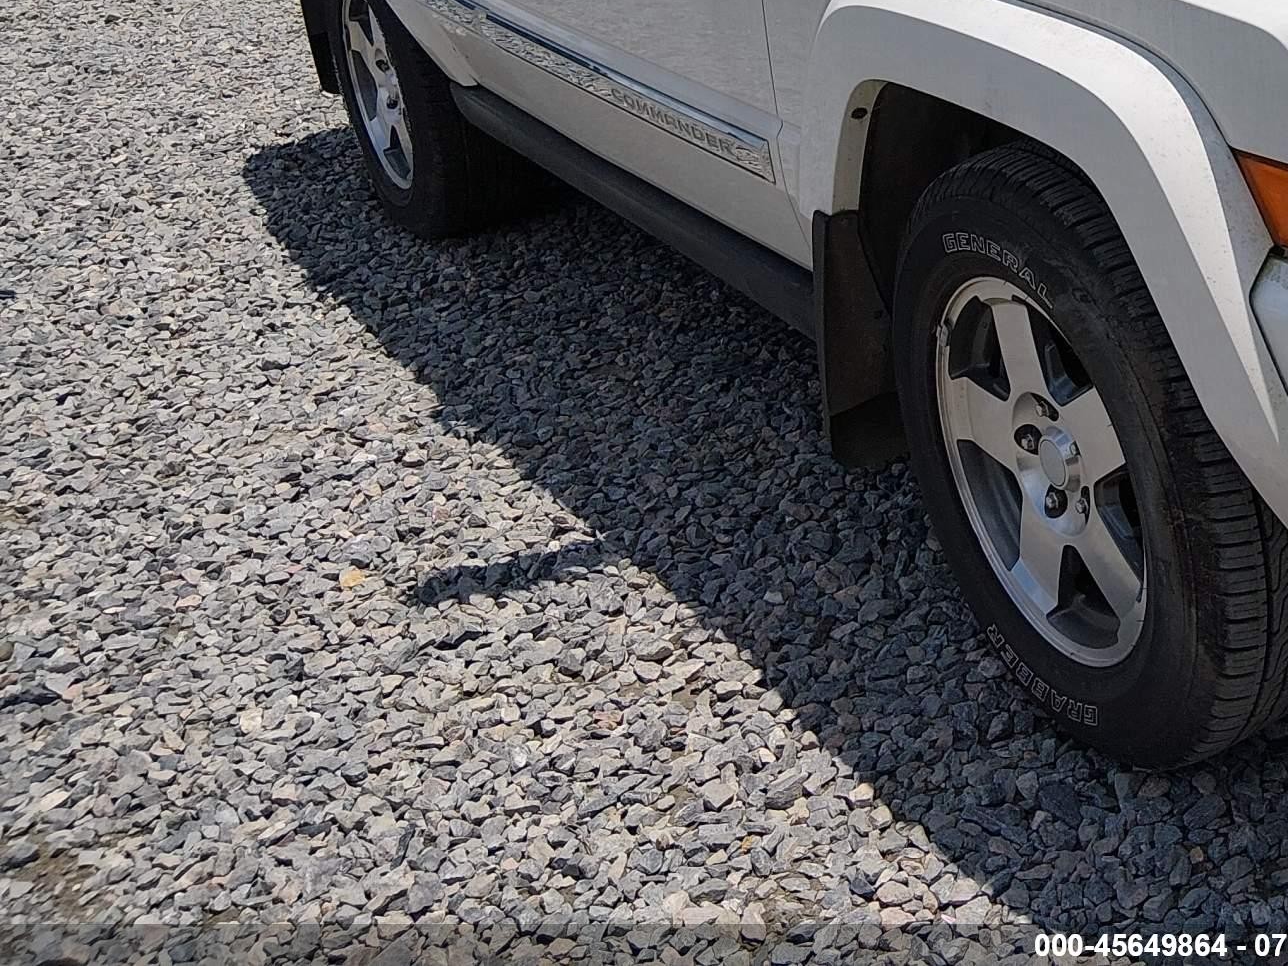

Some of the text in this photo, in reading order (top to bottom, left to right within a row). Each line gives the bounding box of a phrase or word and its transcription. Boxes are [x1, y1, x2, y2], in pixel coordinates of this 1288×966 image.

[611, 88, 736, 155] COMMANDER
[942, 232, 1053, 309] GENERAL
[986, 623, 1098, 726] GRABBER
